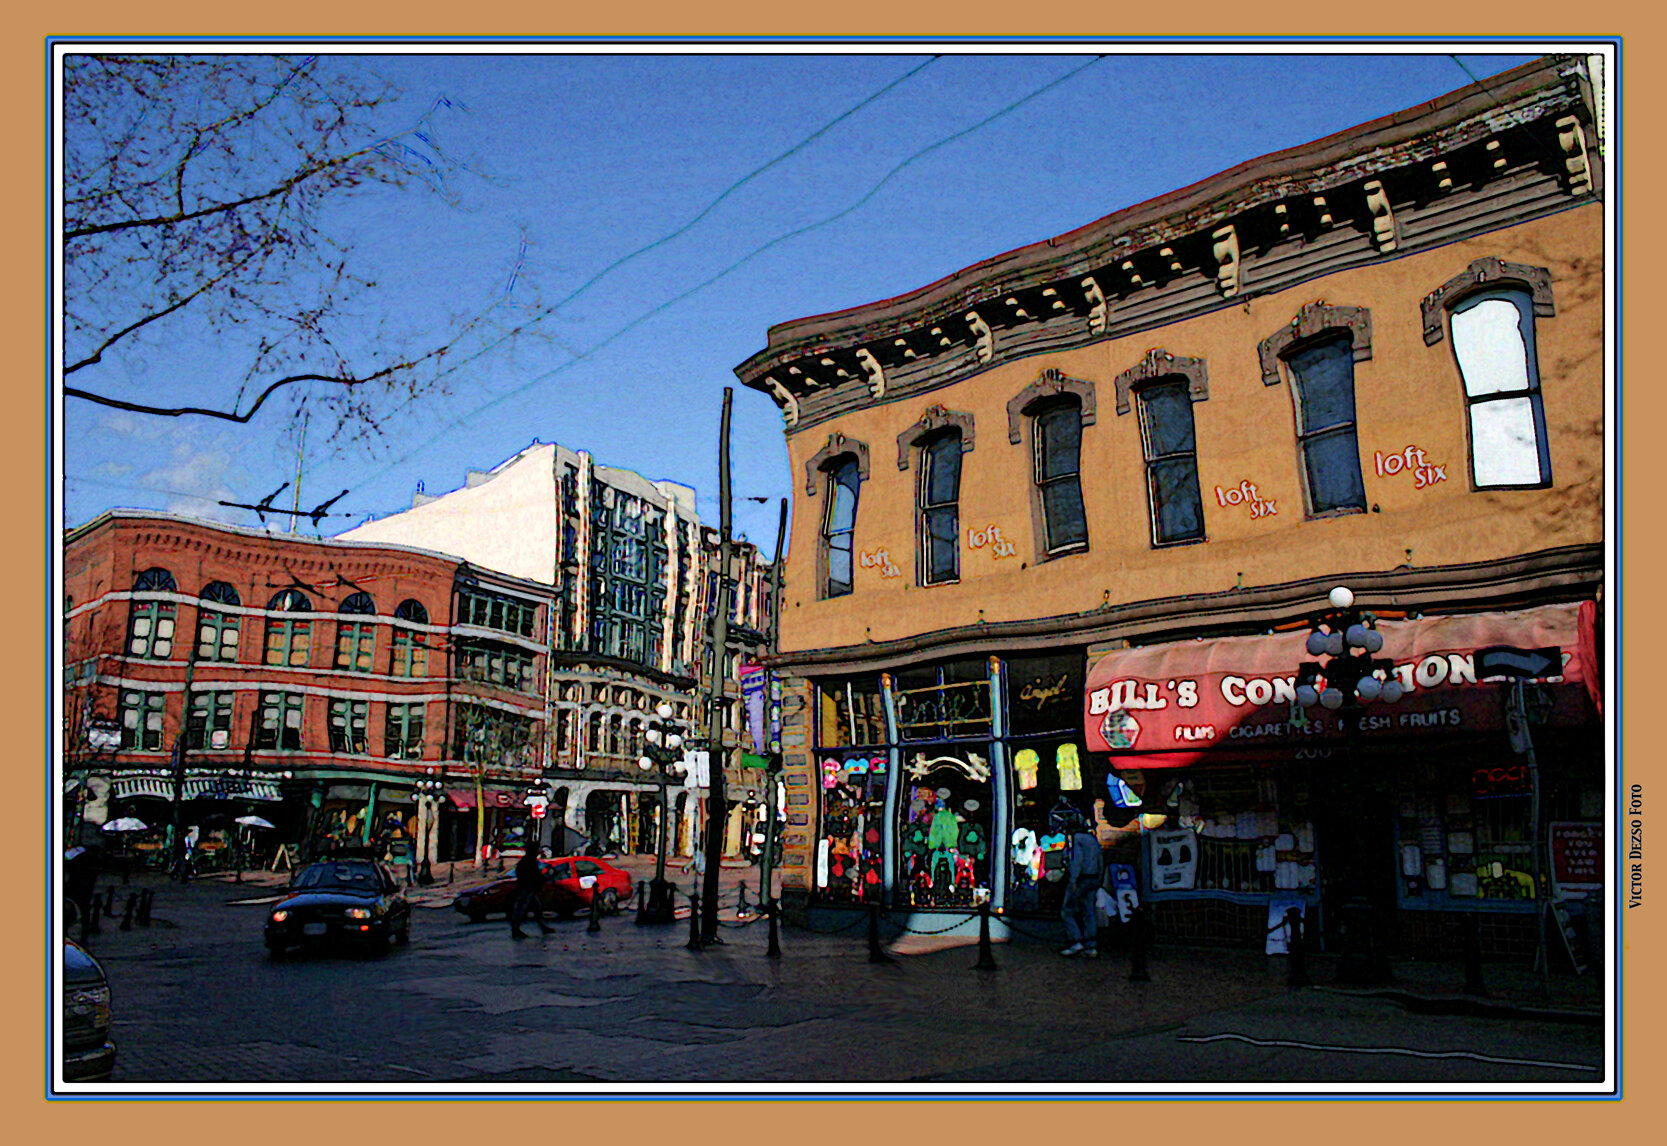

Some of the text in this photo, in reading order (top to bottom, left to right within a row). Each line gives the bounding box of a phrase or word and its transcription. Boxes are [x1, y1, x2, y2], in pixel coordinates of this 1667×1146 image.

[1374, 445, 1430, 478] loft
[1413, 464, 1447, 490] six
[1214, 480, 1262, 508] loft
[1249, 498, 1278, 520] six
[967, 524, 1003, 549] loft
[860, 547, 891, 568] loft
[993, 539, 1017, 560] six
[1088, 678, 1200, 716] BILL'S
[1398, 707, 1463, 728] FRUITS
